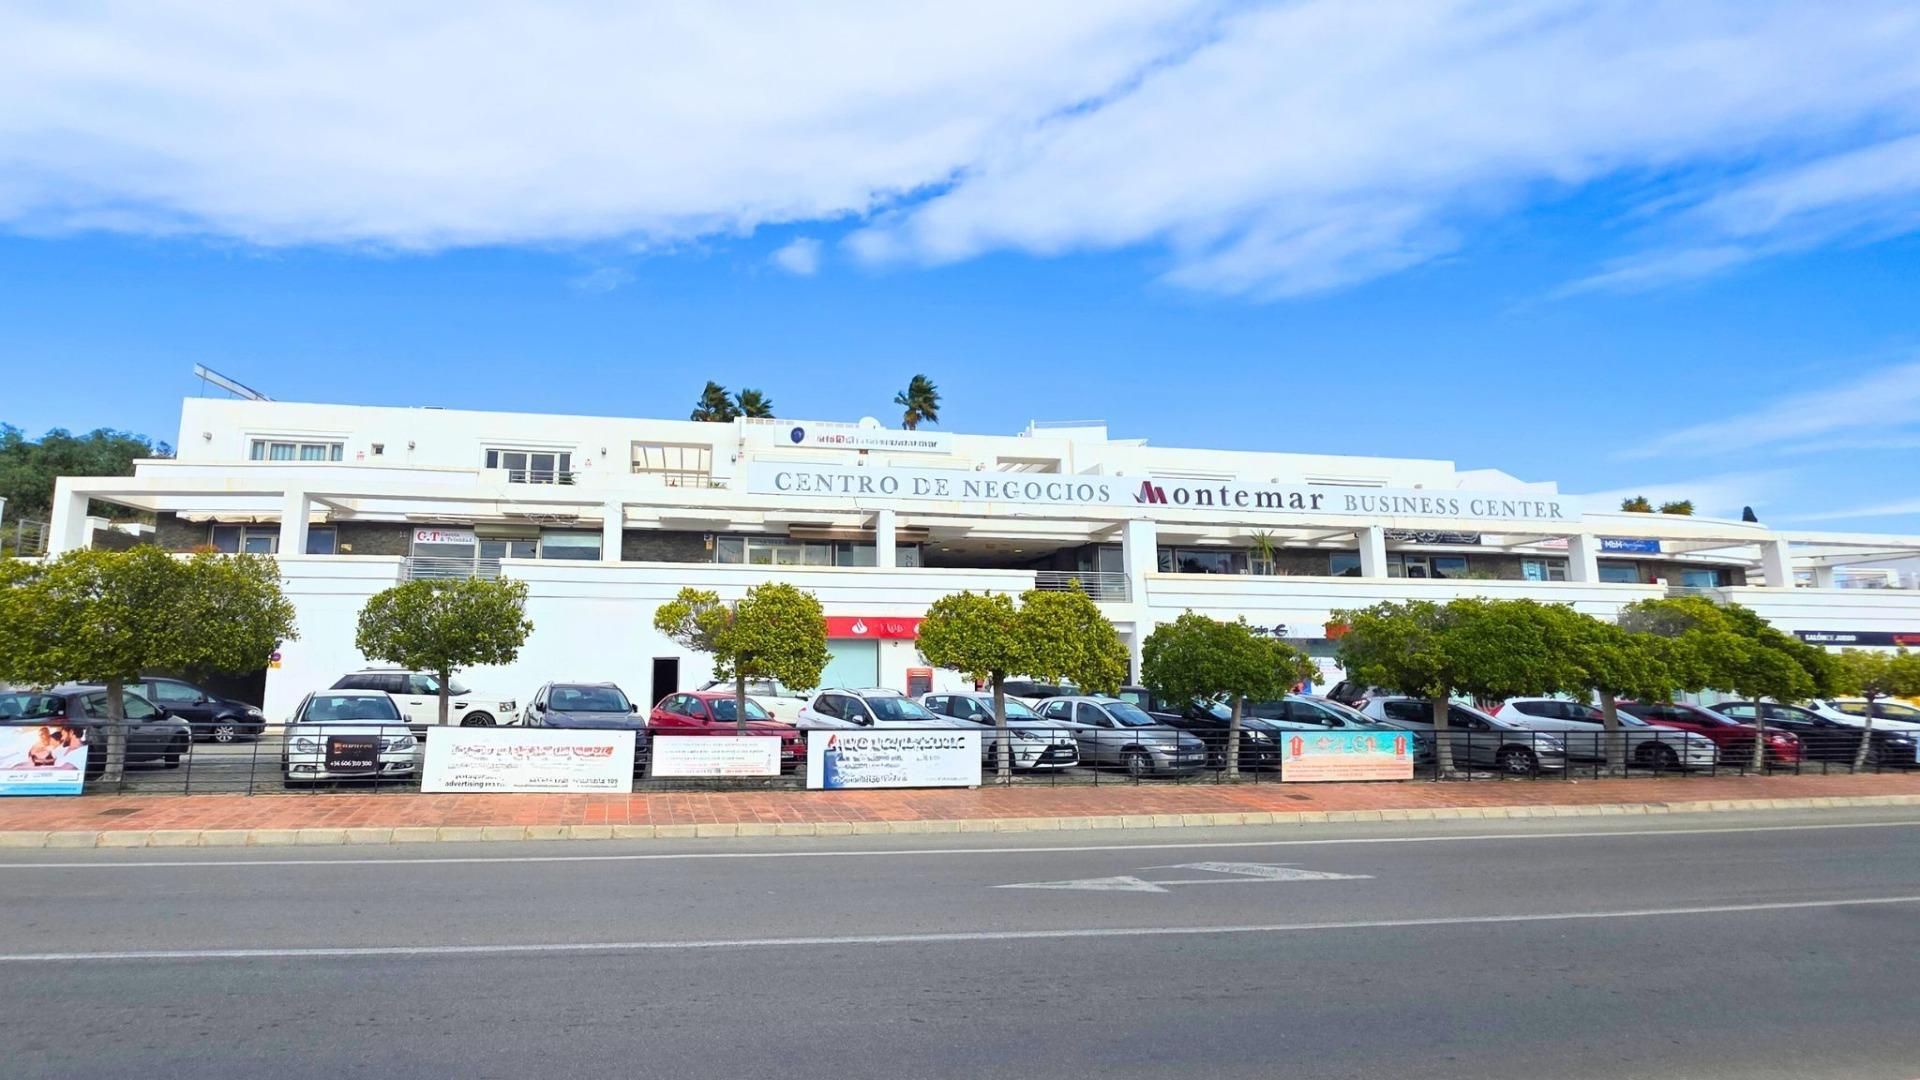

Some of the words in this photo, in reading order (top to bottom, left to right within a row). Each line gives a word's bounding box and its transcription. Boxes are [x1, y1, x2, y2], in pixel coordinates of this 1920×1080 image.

[775, 472, 899, 494] CENTRO
[913, 478, 950, 496] DE
[963, 480, 1111, 502] NEGOCIOS
[1132, 480, 1324, 511] Montemar
[1345, 494, 1460, 516] BUSINESS
[1470, 499, 1562, 519] CENTER
[445, 780, 484, 789] advertising
